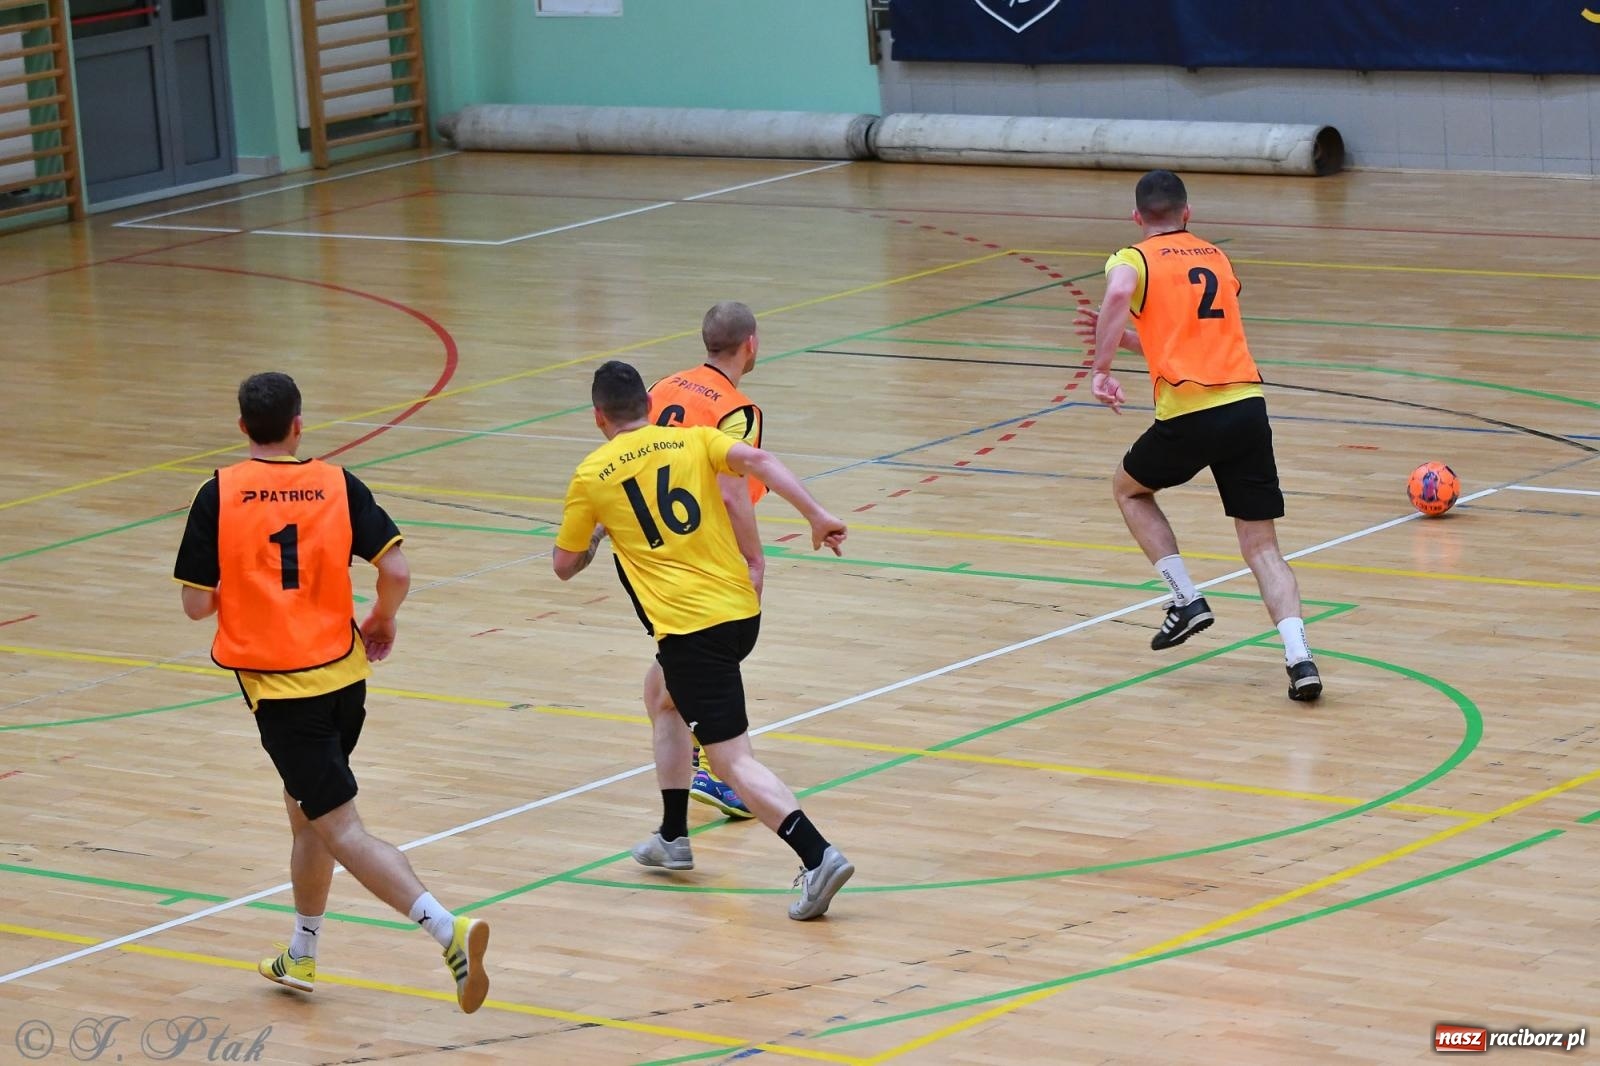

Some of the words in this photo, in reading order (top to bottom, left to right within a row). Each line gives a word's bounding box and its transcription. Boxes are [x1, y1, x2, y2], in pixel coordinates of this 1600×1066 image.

[1188, 267, 1225, 319] 2
[678, 379, 723, 402] PATRICK
[260, 489, 325, 502] PATRICK
[621, 464, 701, 549] 16
[269, 524, 300, 591] 1
